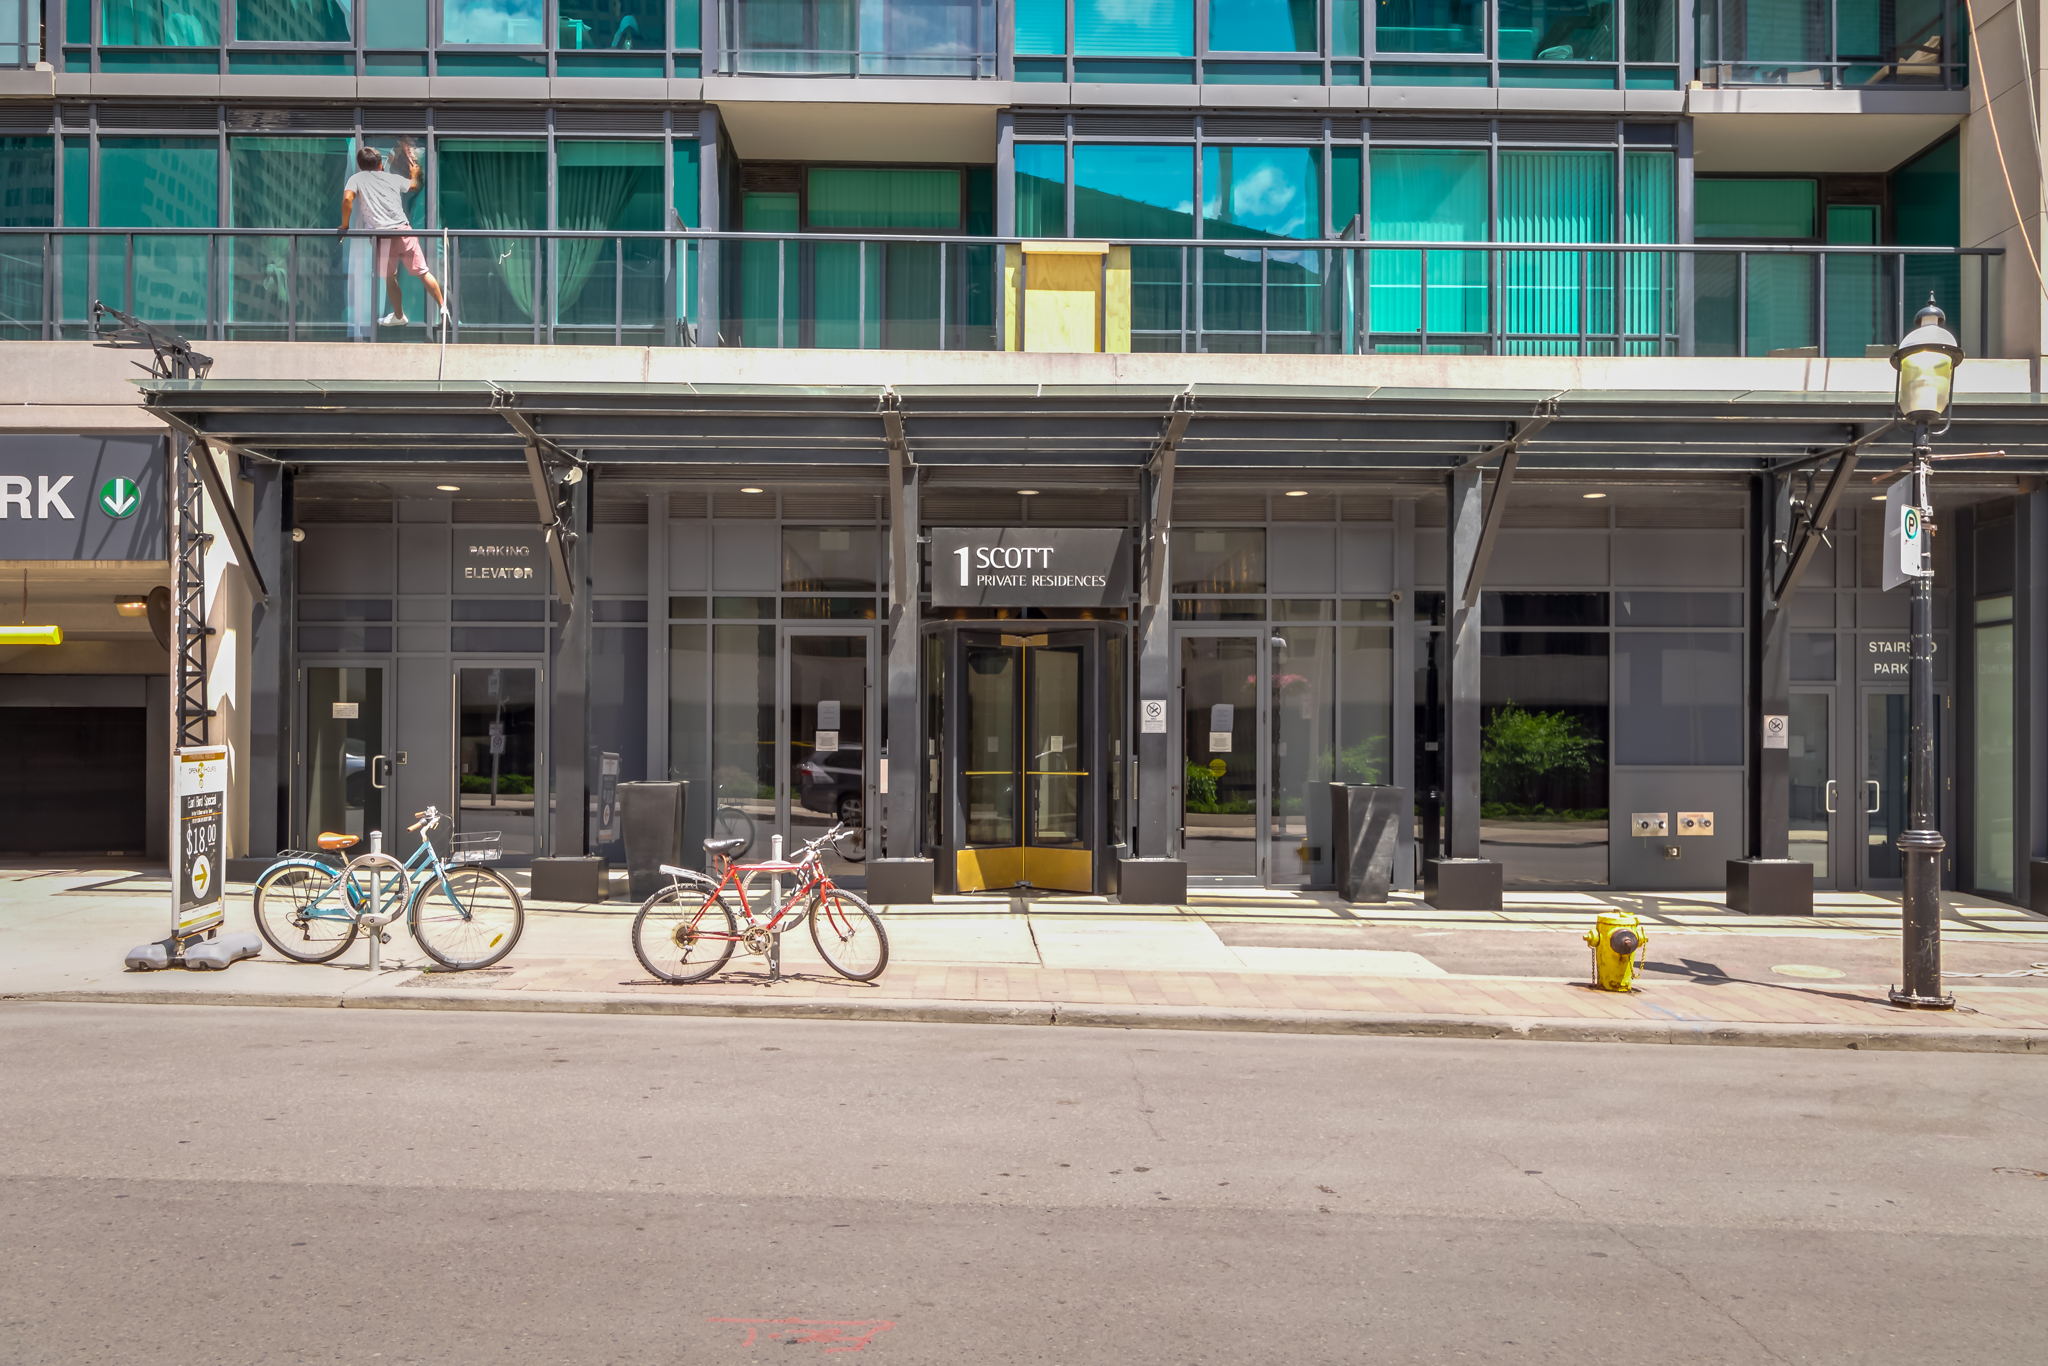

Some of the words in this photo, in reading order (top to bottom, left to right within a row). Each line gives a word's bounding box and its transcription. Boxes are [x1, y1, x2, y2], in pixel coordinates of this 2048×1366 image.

[469, 545, 530, 557] PARKING
[953, 546, 969, 587] 1
[976, 547, 1054, 569] SCOTT
[464, 567, 533, 579] ELEVATOR
[976, 575, 1027, 587] PRIVATE
[1032, 575, 1107, 587] RESIDENCES
